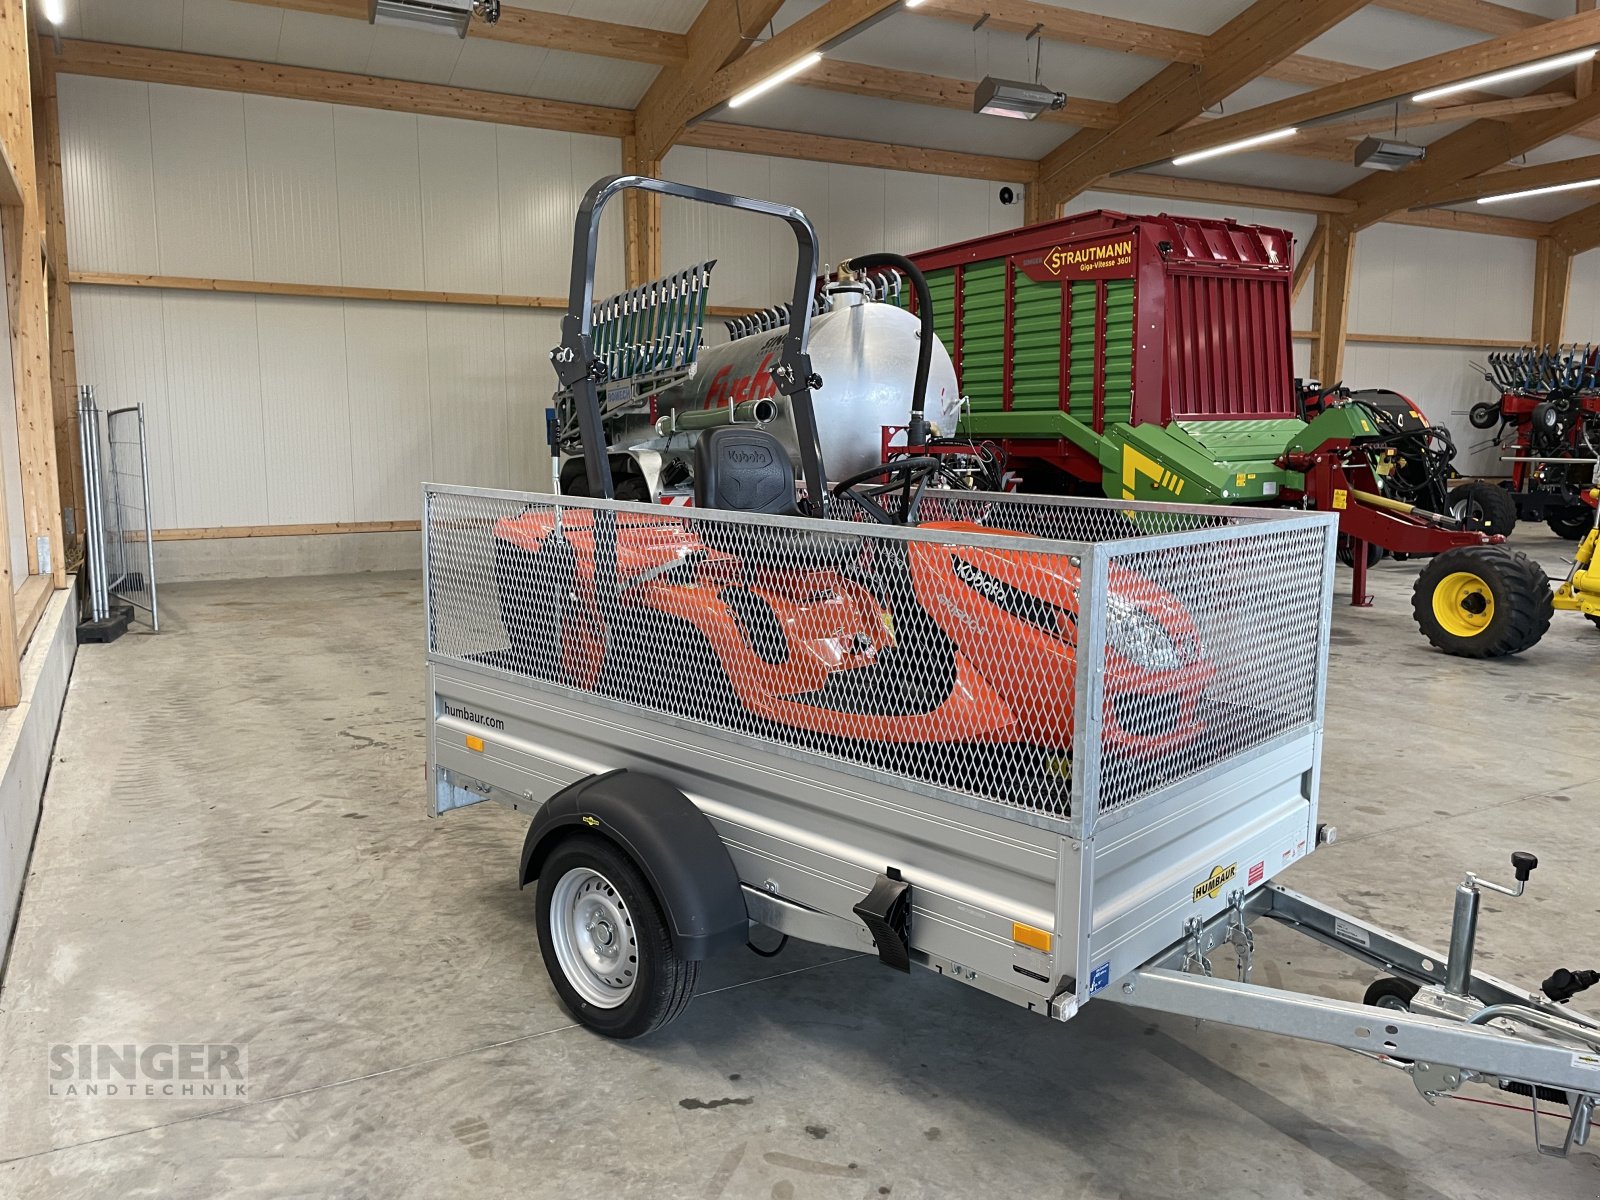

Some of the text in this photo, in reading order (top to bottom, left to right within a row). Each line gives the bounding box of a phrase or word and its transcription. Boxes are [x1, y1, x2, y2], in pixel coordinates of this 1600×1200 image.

[1052, 241, 1132, 268] STRAUTMANN
[1080, 259, 1115, 271] Giga-Vitesse
[728, 450, 766, 462] Kubota
[956, 564, 1005, 601] Kubota
[444, 701, 504, 730] humbaur.com
[1195, 867, 1235, 898] HUMBAUR
